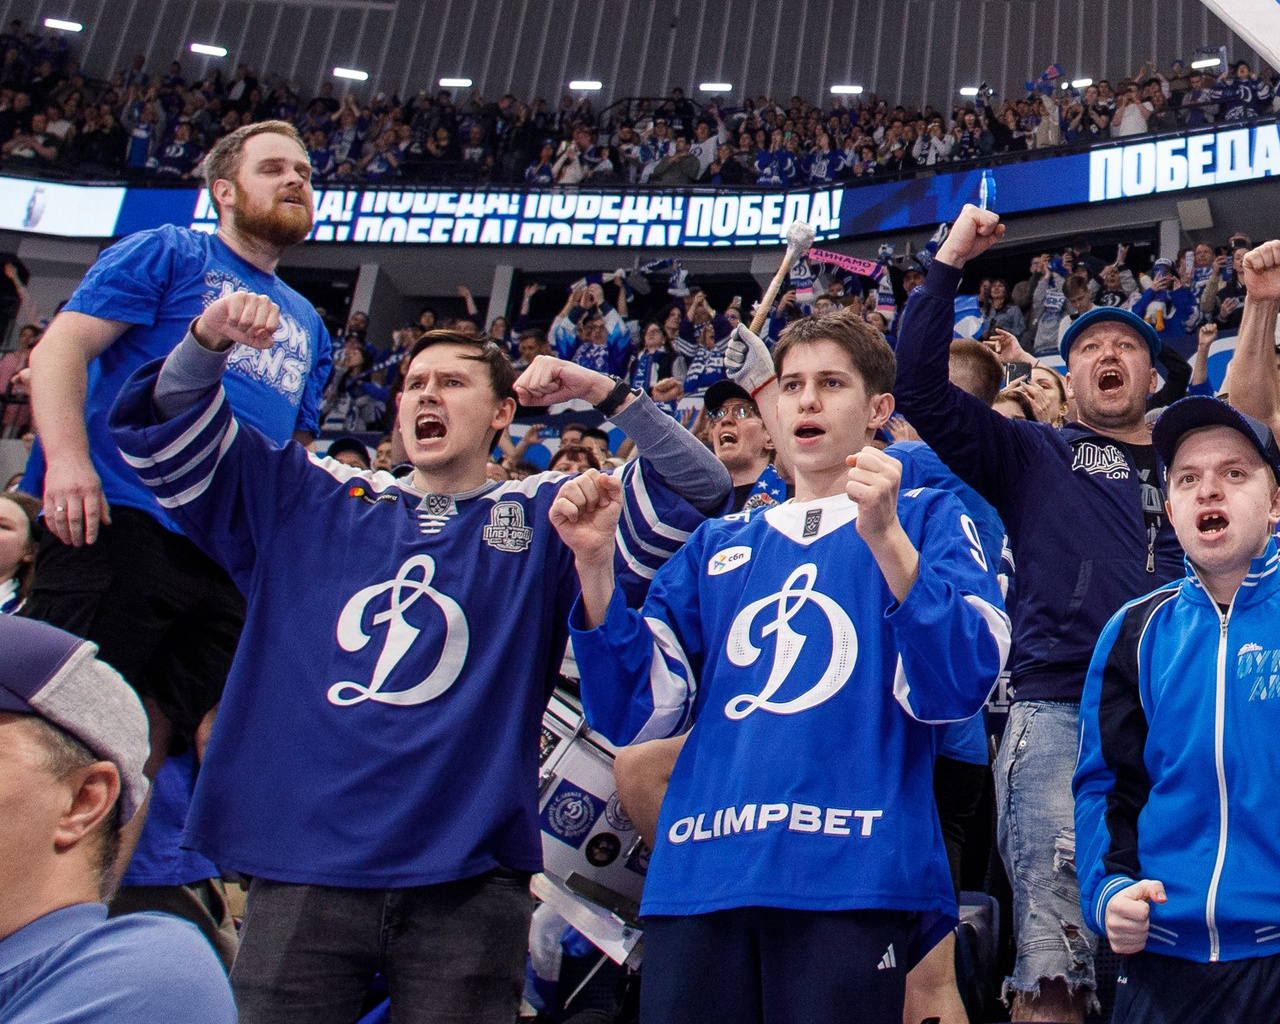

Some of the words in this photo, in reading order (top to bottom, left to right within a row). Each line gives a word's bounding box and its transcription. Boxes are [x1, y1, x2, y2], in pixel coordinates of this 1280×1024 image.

[684, 189, 844, 238] ПОБЕДА!
[814, 249, 872, 268] ДИНАМО
[1106, 471, 1129, 479] LON
[728, 552, 744, 562] сбп
[668, 803, 883, 844] OLIMPBET
